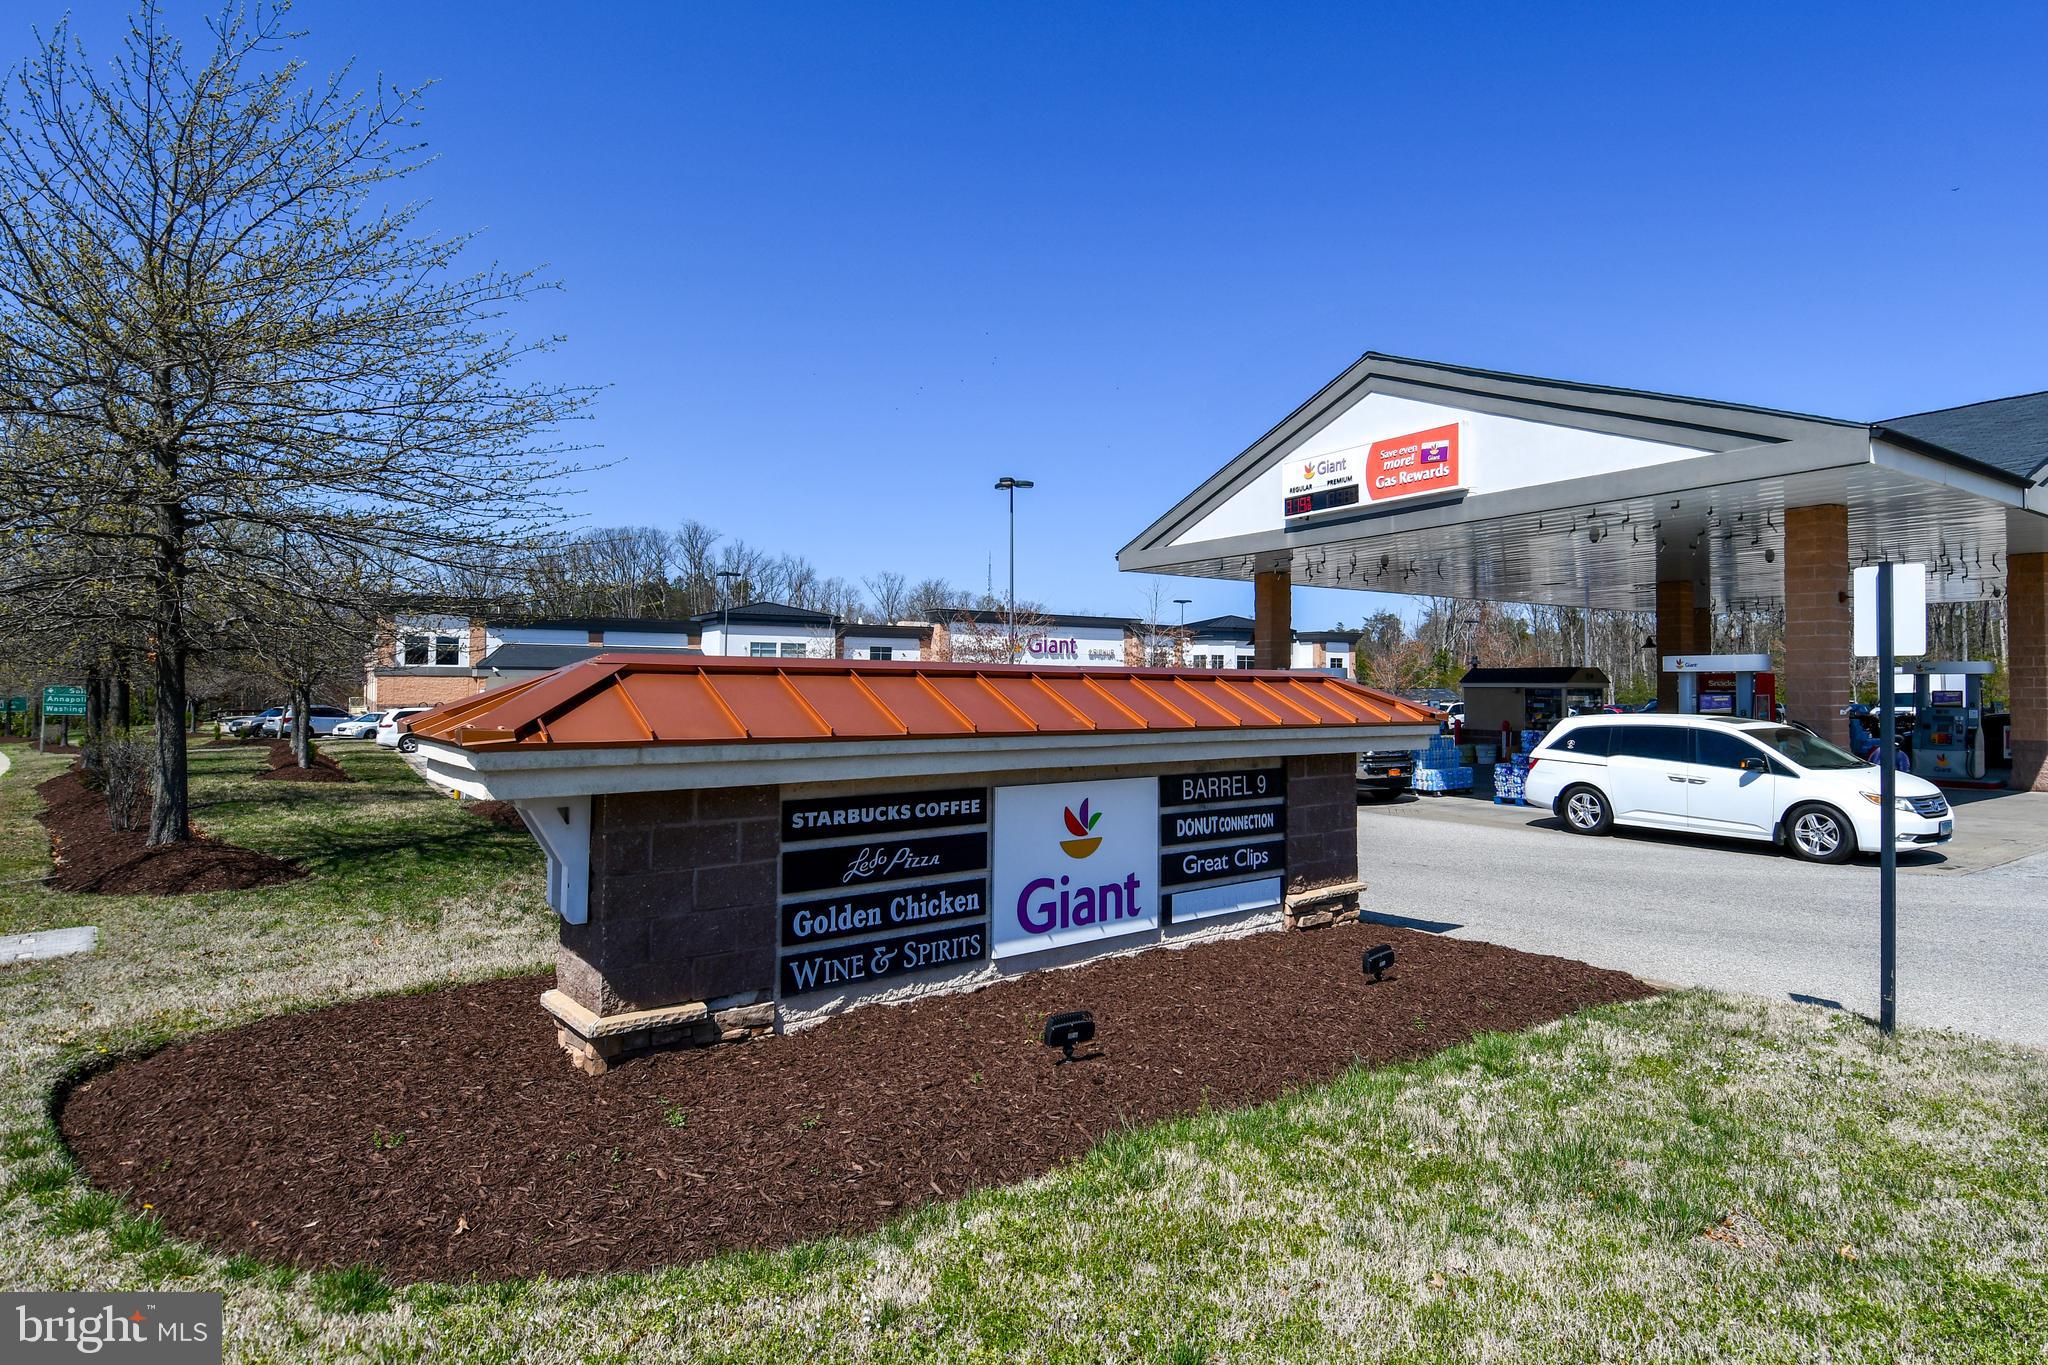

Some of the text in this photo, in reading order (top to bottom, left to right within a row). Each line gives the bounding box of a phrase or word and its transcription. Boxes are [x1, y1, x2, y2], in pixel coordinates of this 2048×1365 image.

[1380, 445, 1417, 459] Save even
[1383, 453, 1415, 470] more!
[1317, 457, 1347, 476] Giant
[1376, 463, 1450, 488] Gas Rewards
[1289, 484, 1313, 494] REGULAR
[1327, 475, 1353, 486] PREMIUM
[1028, 634, 1077, 654] Giant
[1182, 775, 1267, 800] BARREL 9
[791, 799, 980, 829] STARBUCKS COFFEE
[1176, 812, 1274, 837] DONUT CONNECTION
[842, 847, 887, 883] Ledo
[1183, 849, 1269, 875] Great Clips
[793, 890, 979, 937] Golden Chicken
[1017, 872, 1142, 934] Giant
[789, 934, 981, 990] WINE & SPIRITS
